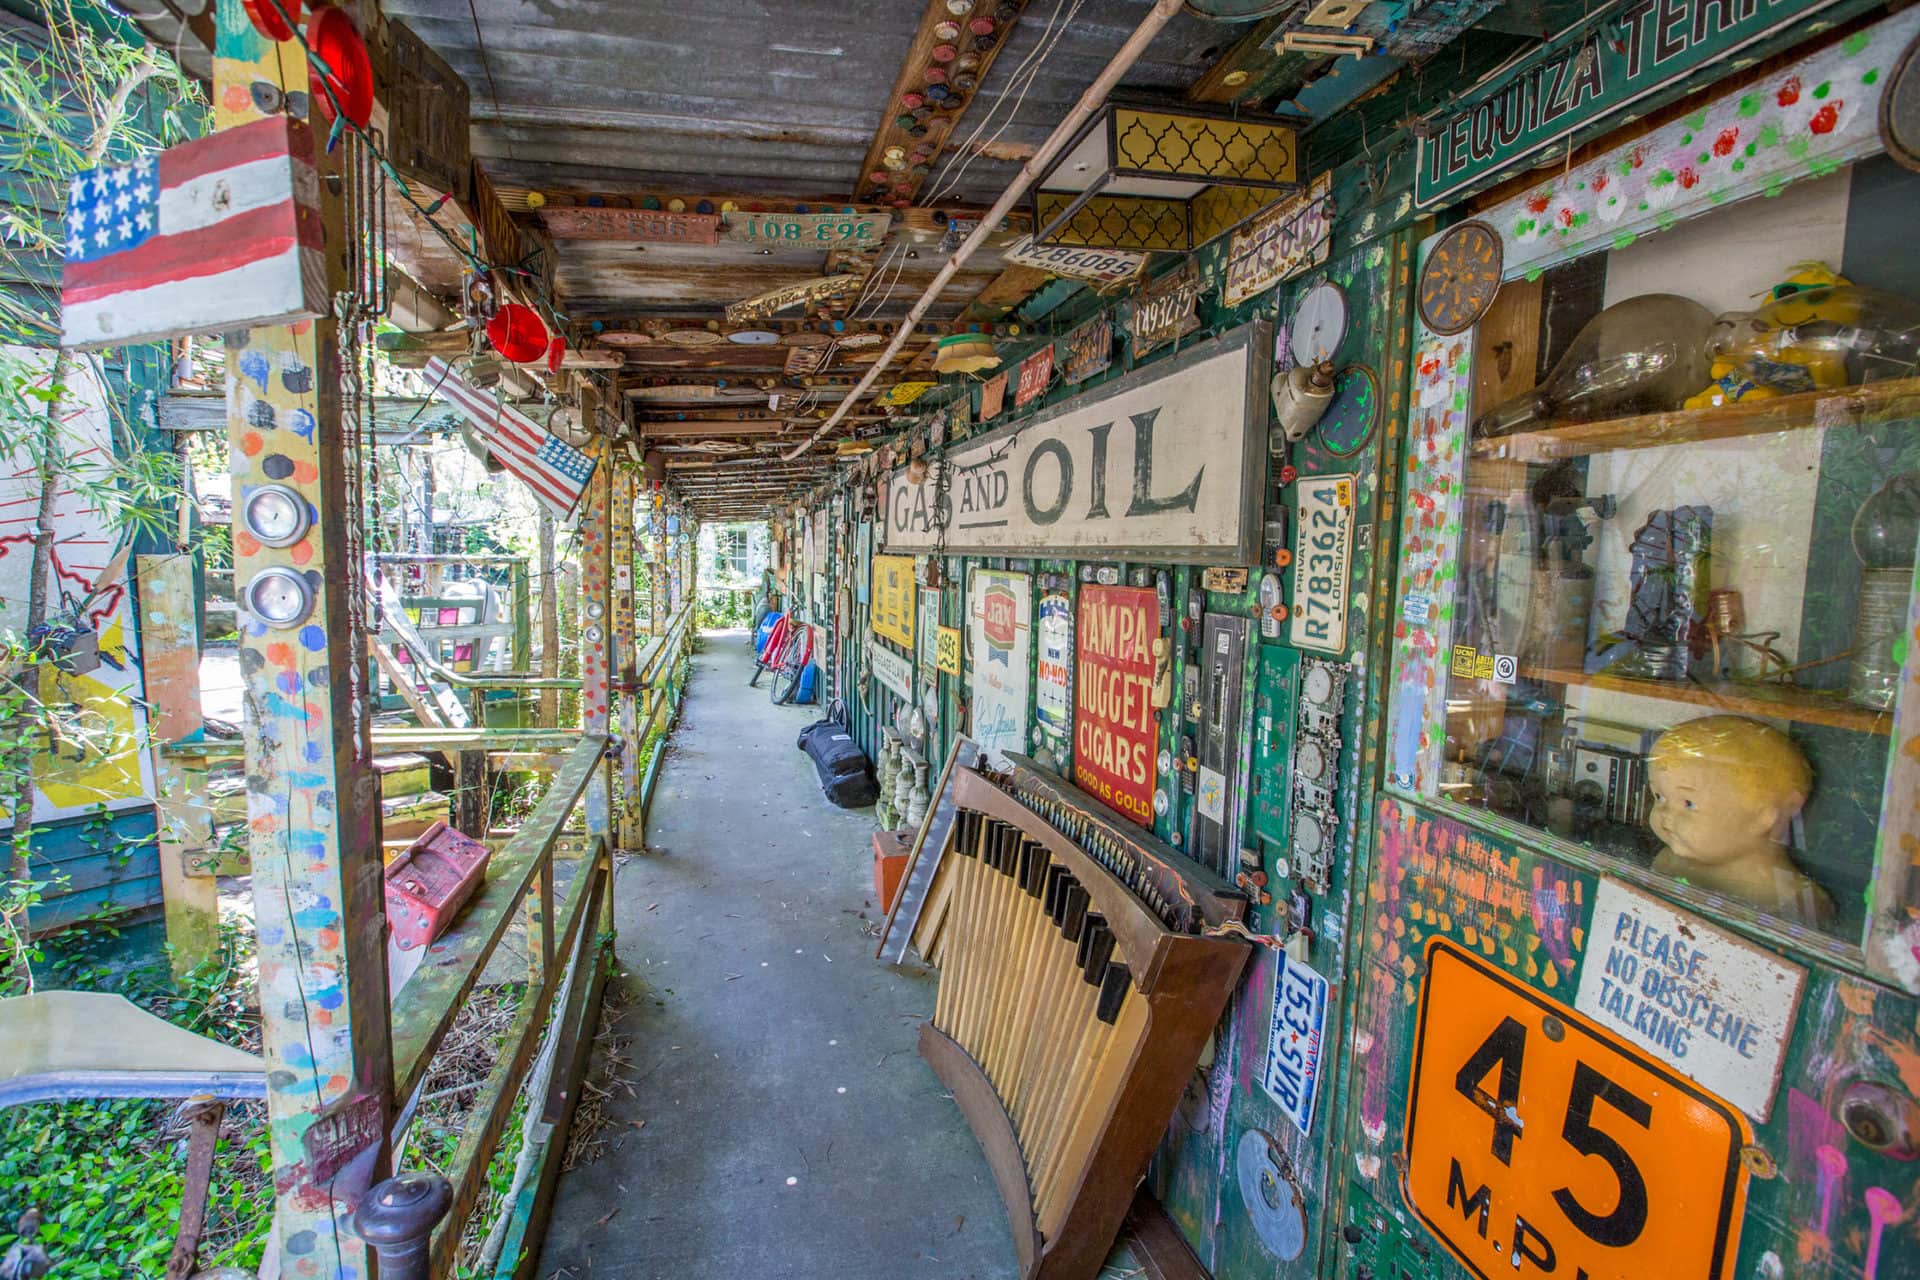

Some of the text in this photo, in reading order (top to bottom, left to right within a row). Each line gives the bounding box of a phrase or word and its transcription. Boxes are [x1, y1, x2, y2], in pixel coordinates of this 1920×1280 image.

[1427, 34, 1604, 185] TEQUIZA
[960, 470, 1009, 514] AND
[1023, 406, 1206, 526] OIL
[1296, 529, 1308, 594] PRIVATE
[1304, 487, 1339, 640] R783624
[1332, 518, 1348, 611] LOUISIANA
[1047, 647, 1061, 662] NEW
[1081, 600, 1150, 665] TAMPA
[1079, 660, 1154, 734] NUGGET
[1077, 764, 1150, 818] GOOD AS GOLD
[1080, 724, 1148, 786] CIGARS
[1614, 911, 1708, 984] PLEASE
[1598, 977, 1693, 1059] TALKING
[1605, 946, 1763, 1060] NO OBSCENE
[1455, 1015, 1653, 1248] 45
